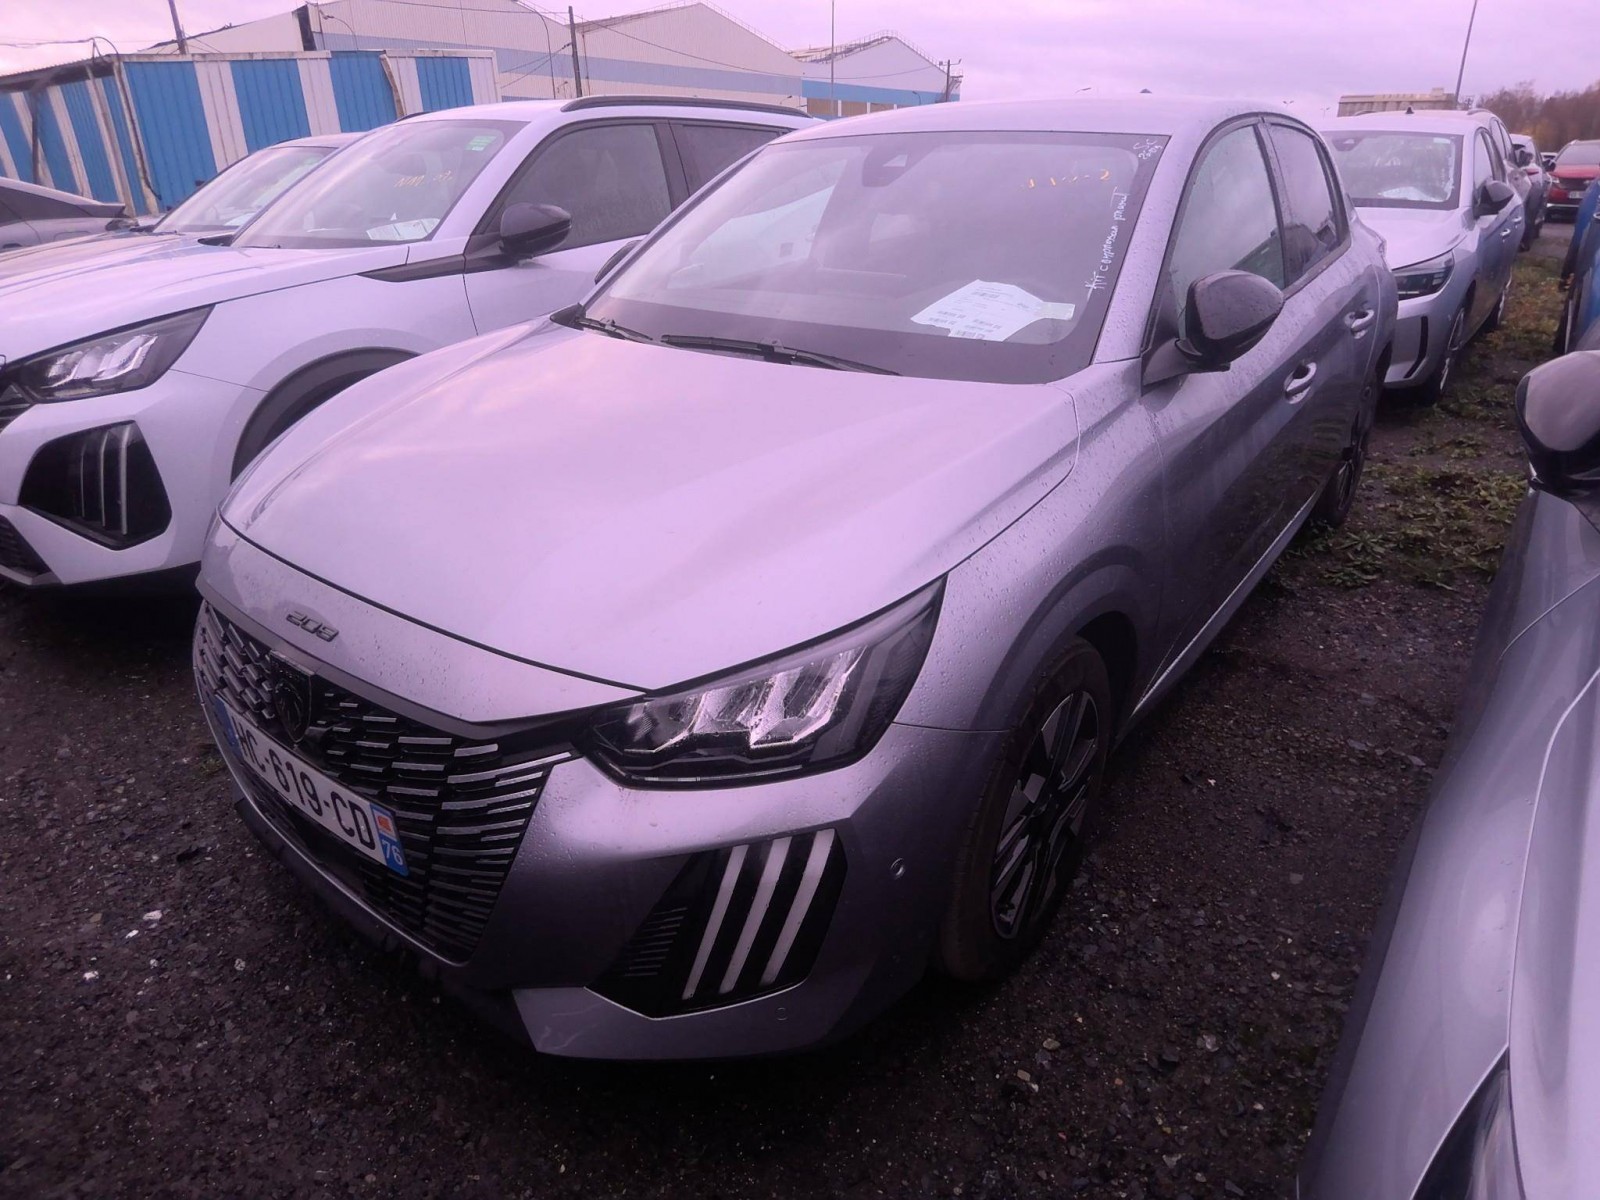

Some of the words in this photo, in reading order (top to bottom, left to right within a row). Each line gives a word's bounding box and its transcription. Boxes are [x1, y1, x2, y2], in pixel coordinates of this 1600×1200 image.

[286, 610, 340, 643] 208
[231, 715, 376, 851] HC-619-CD
[381, 838, 404, 866] 76
